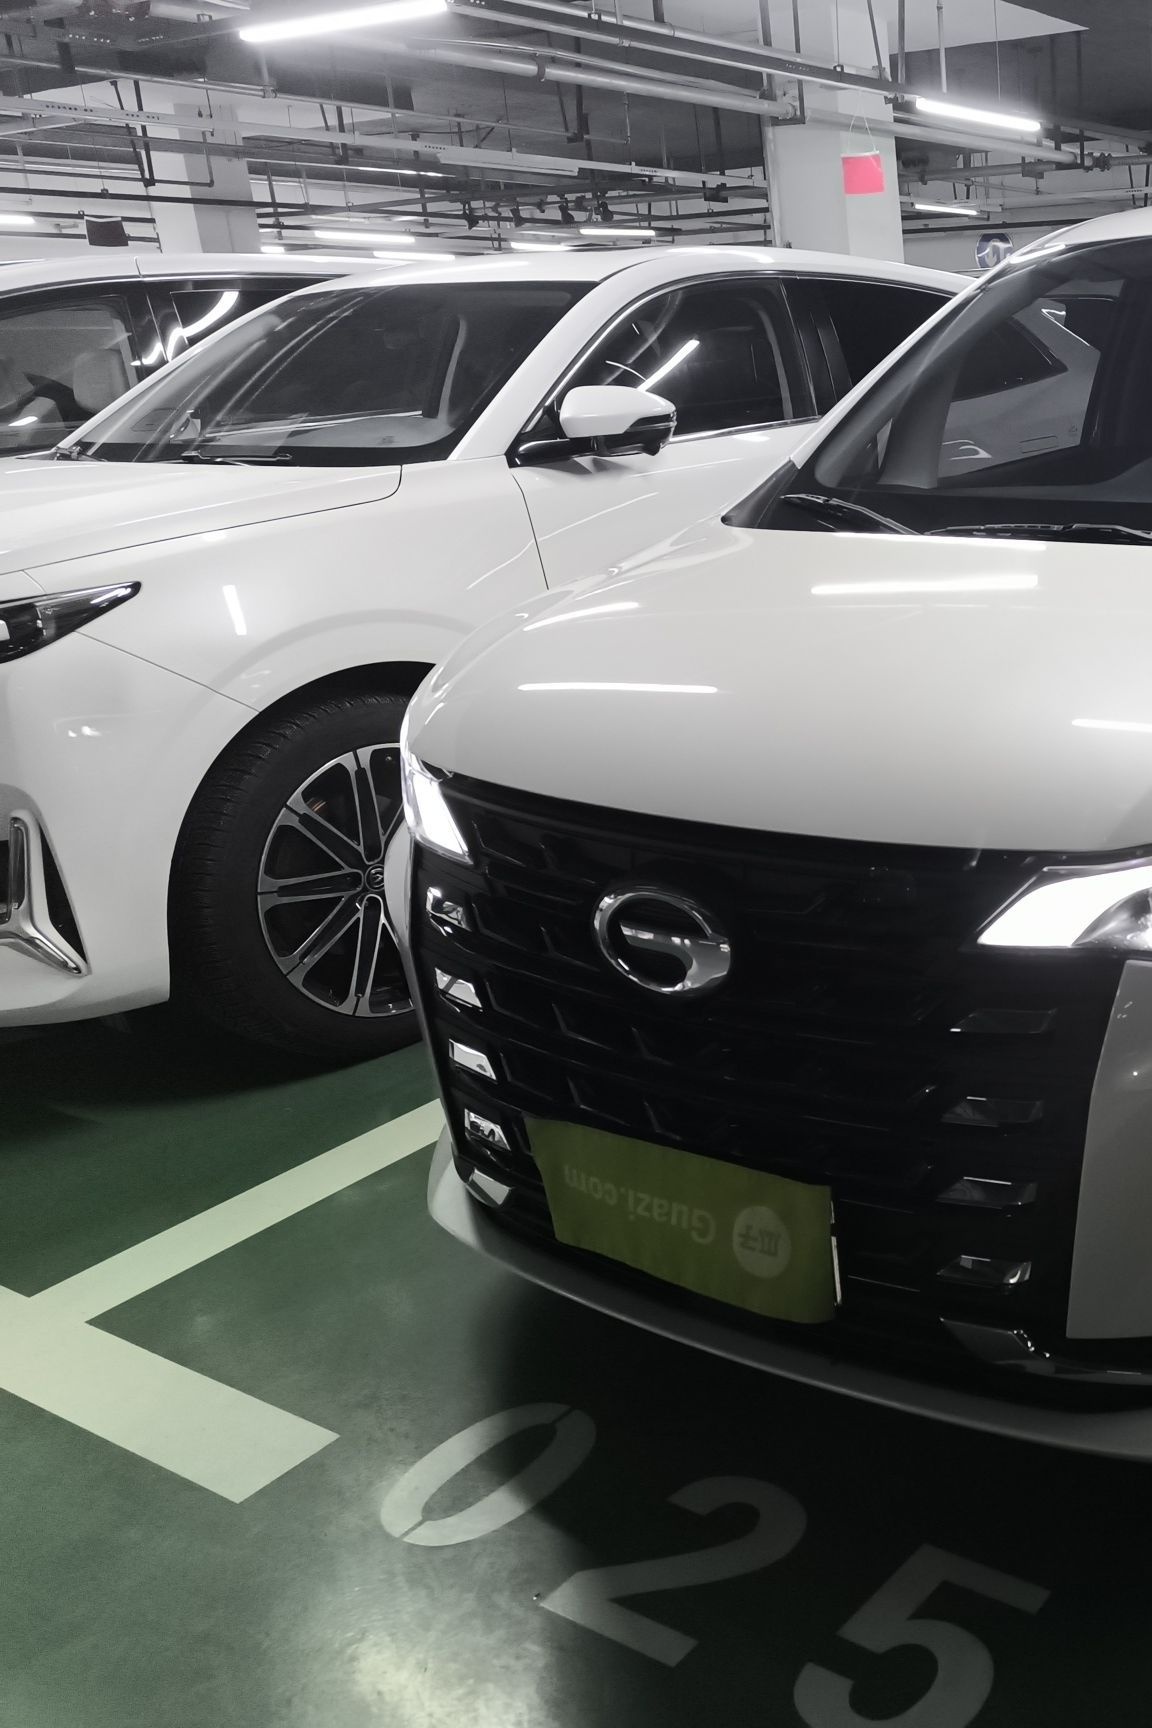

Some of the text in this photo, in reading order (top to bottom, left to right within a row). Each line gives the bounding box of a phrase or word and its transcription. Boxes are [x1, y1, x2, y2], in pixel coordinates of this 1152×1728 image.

[563, 1164, 717, 1246] Guazi.com
[737, 1224, 781, 1258] 瓜子
[379, 1401, 1052, 1728] 025
